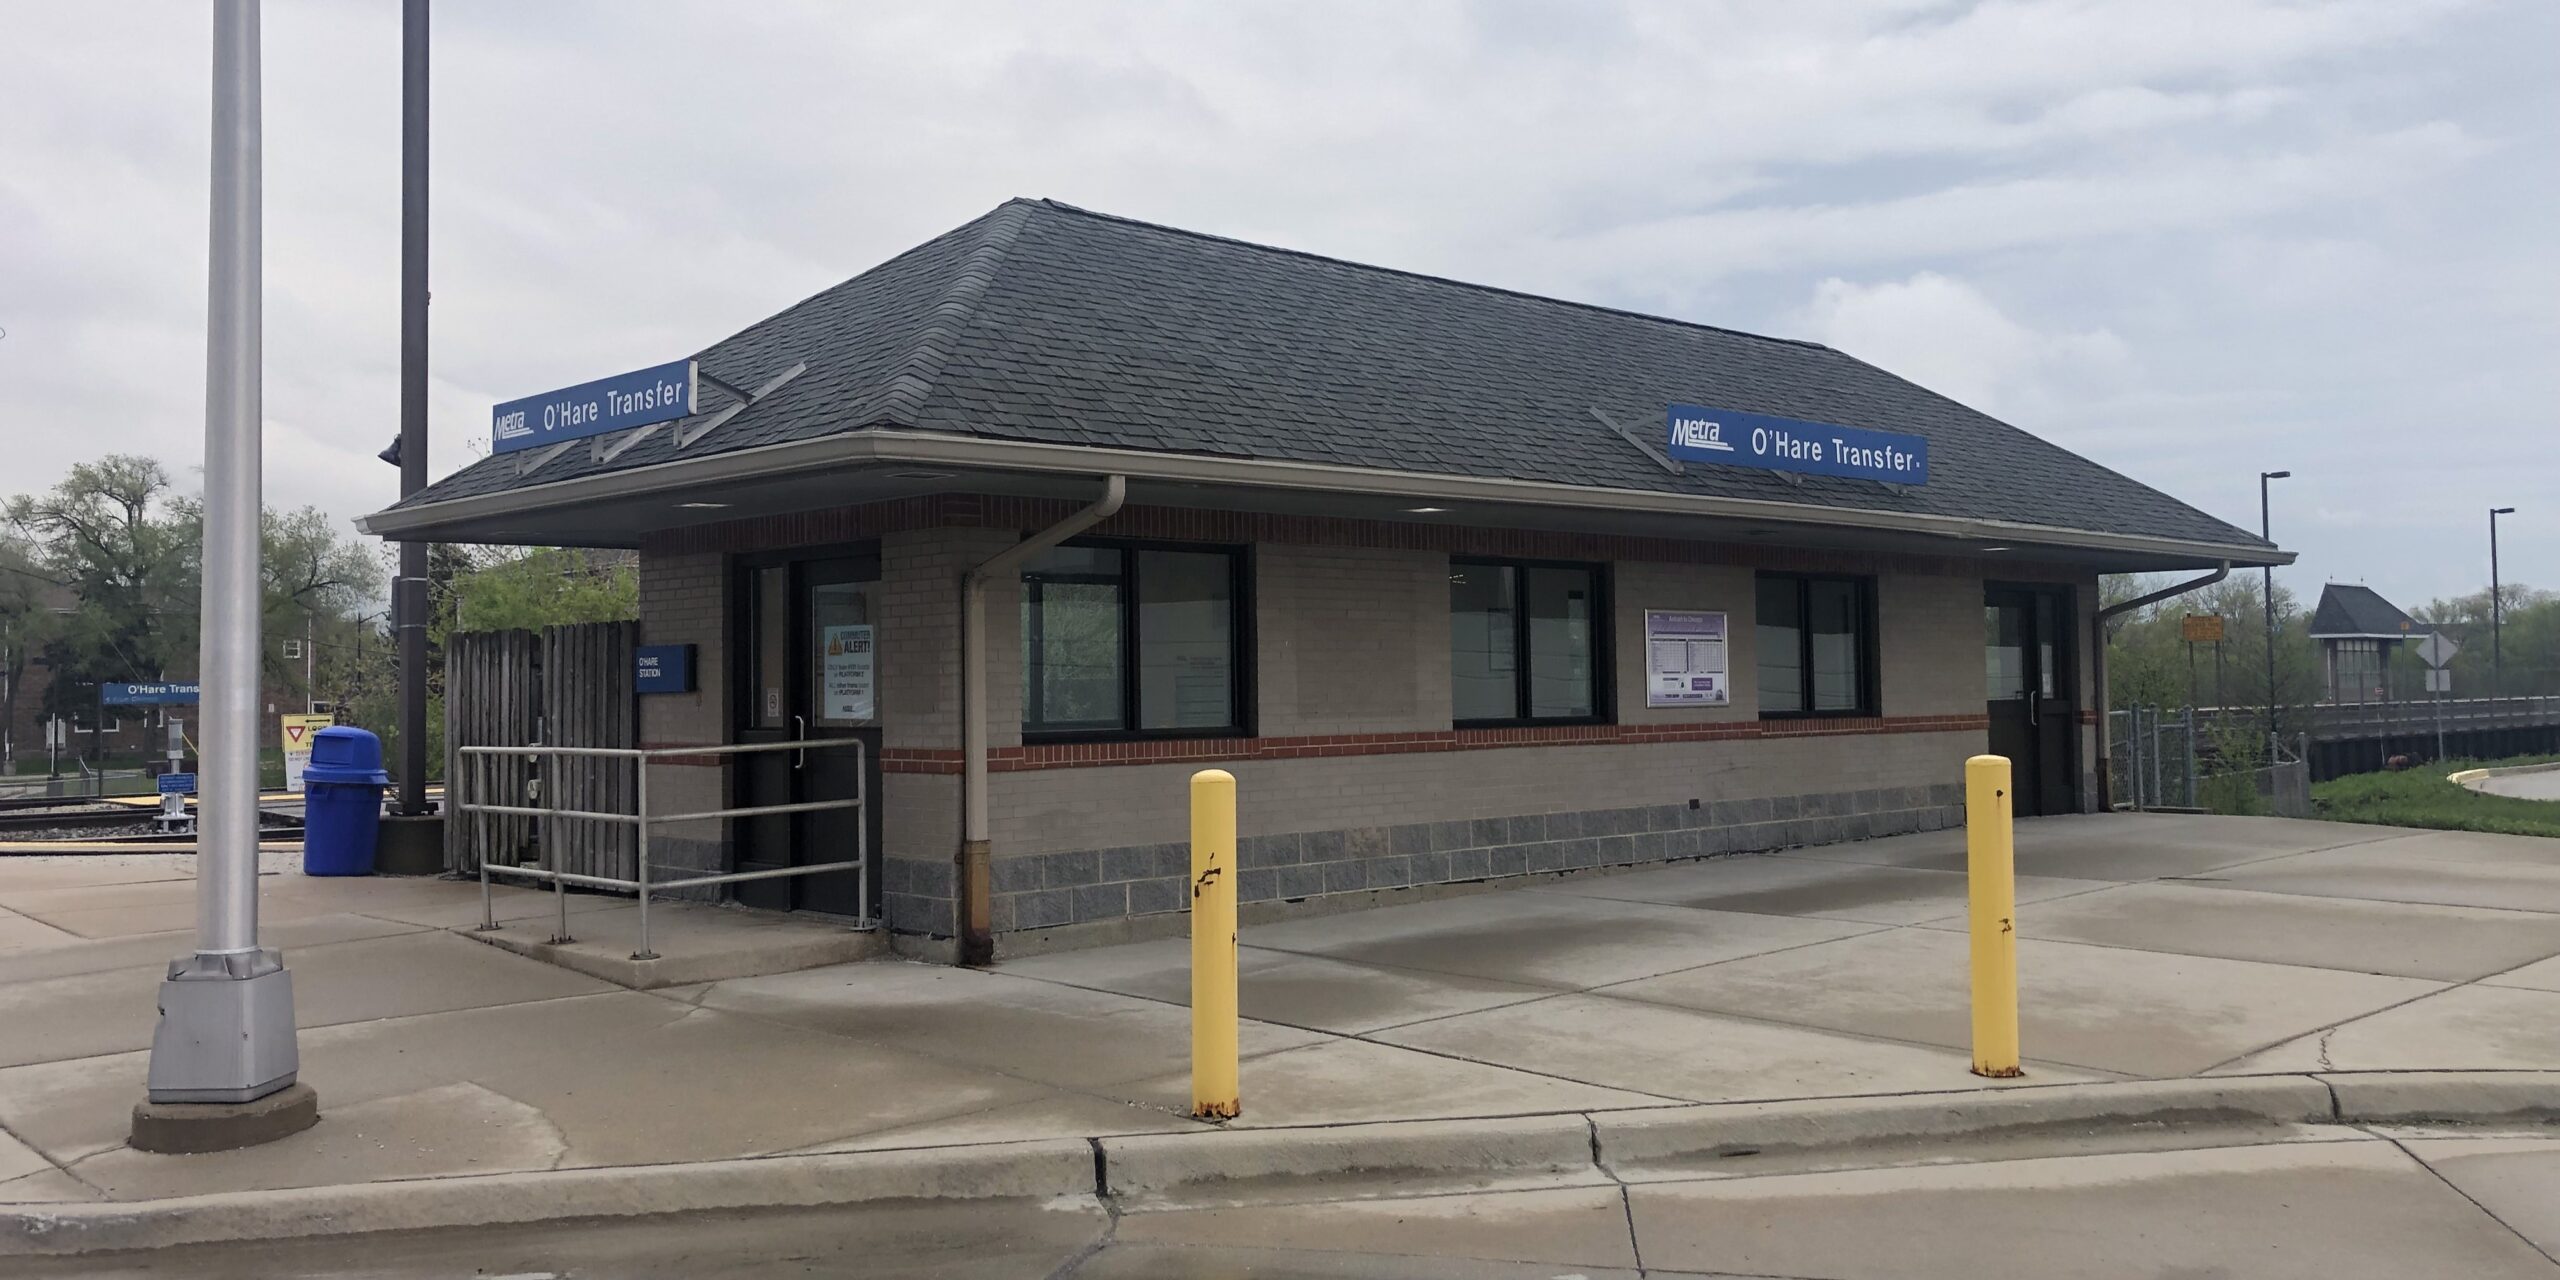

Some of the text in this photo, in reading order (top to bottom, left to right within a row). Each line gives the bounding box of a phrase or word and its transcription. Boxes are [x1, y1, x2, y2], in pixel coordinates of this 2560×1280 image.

[494, 380, 682, 441] Metra O'Hare Transfer
[1671, 418, 1913, 471] Metra O'Hare Transfer
[844, 640, 870, 653] ALERT!
[639, 668, 660, 677] STATION
[128, 685, 166, 694] O'Hare
